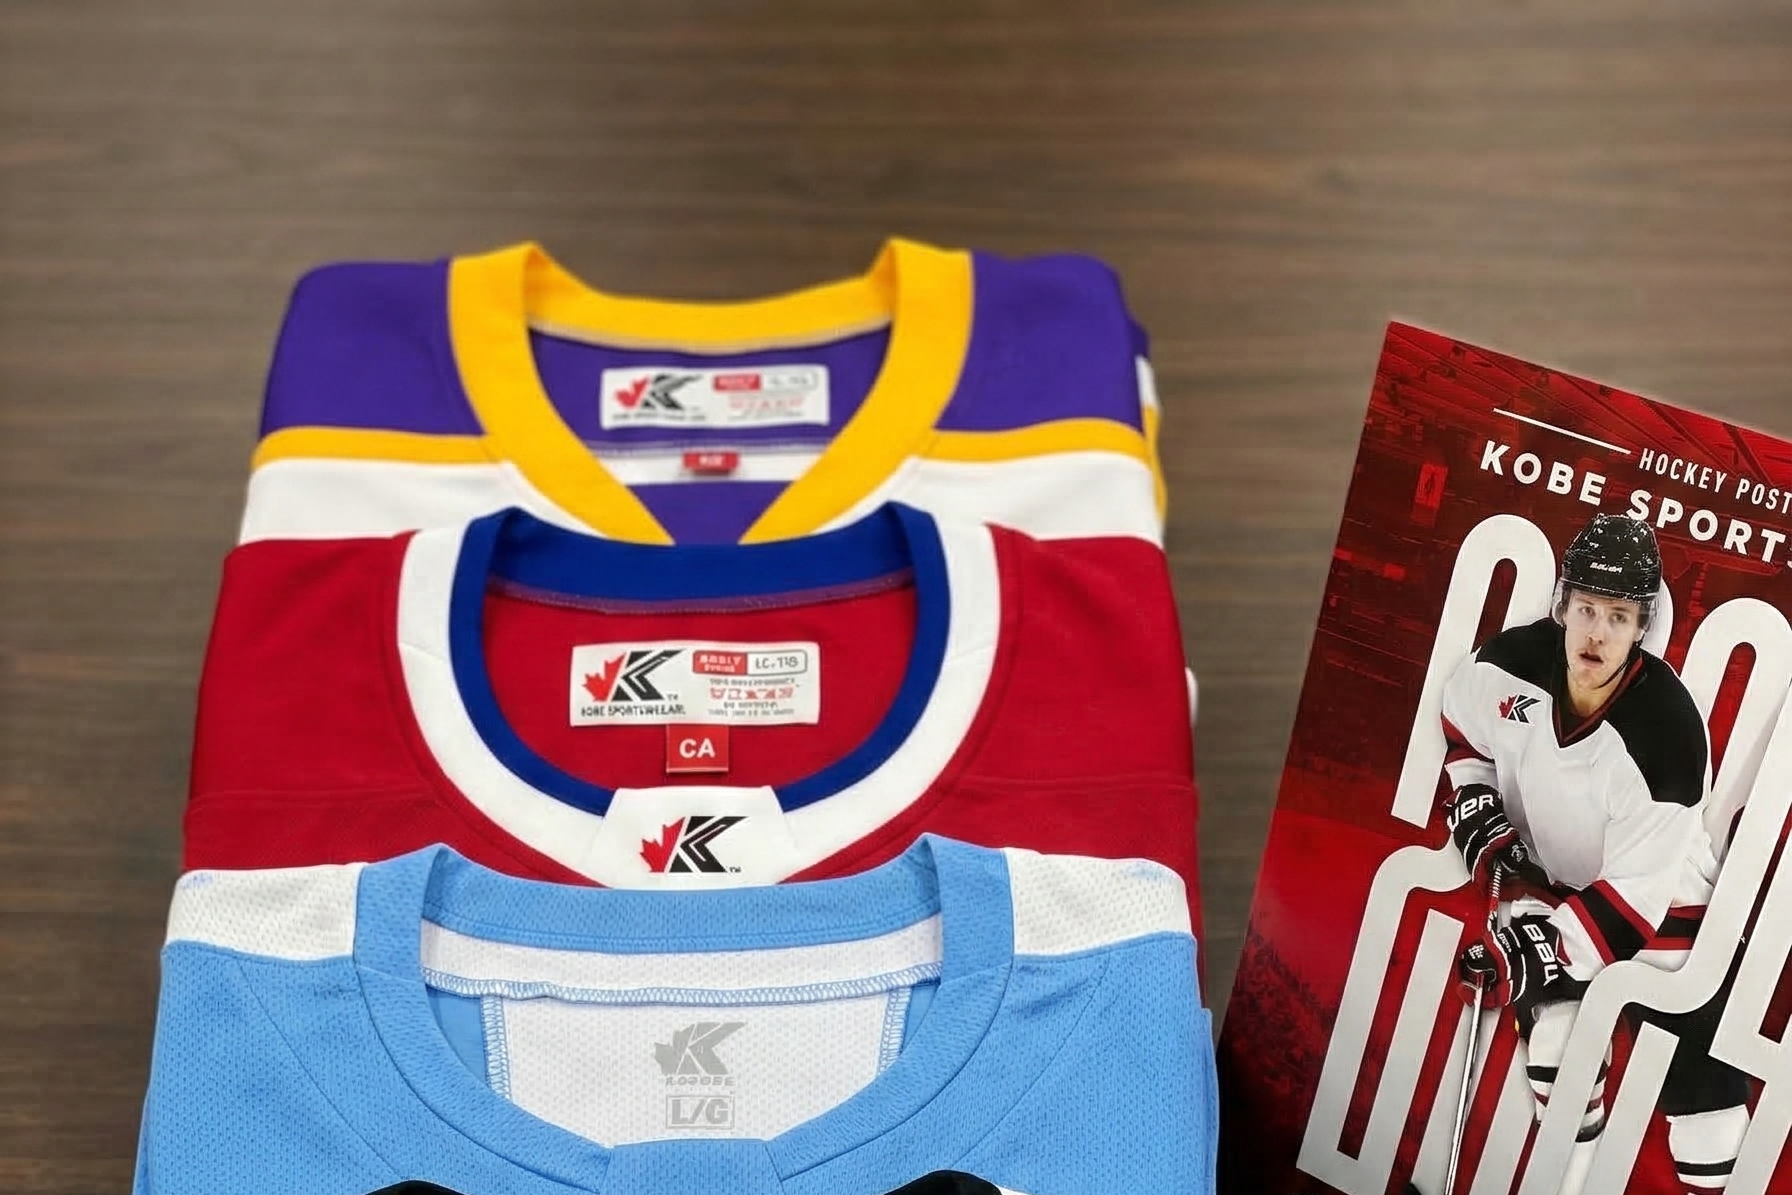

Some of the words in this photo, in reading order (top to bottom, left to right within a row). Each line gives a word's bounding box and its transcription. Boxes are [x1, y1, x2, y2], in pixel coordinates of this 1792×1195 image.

[1638, 448, 1728, 493] HOCKEY
[1480, 440, 1607, 506] KOBE
[1626, 489, 1792, 569] SPORT
[679, 738, 716, 759] CA
[671, 1098, 729, 1125] L/G
